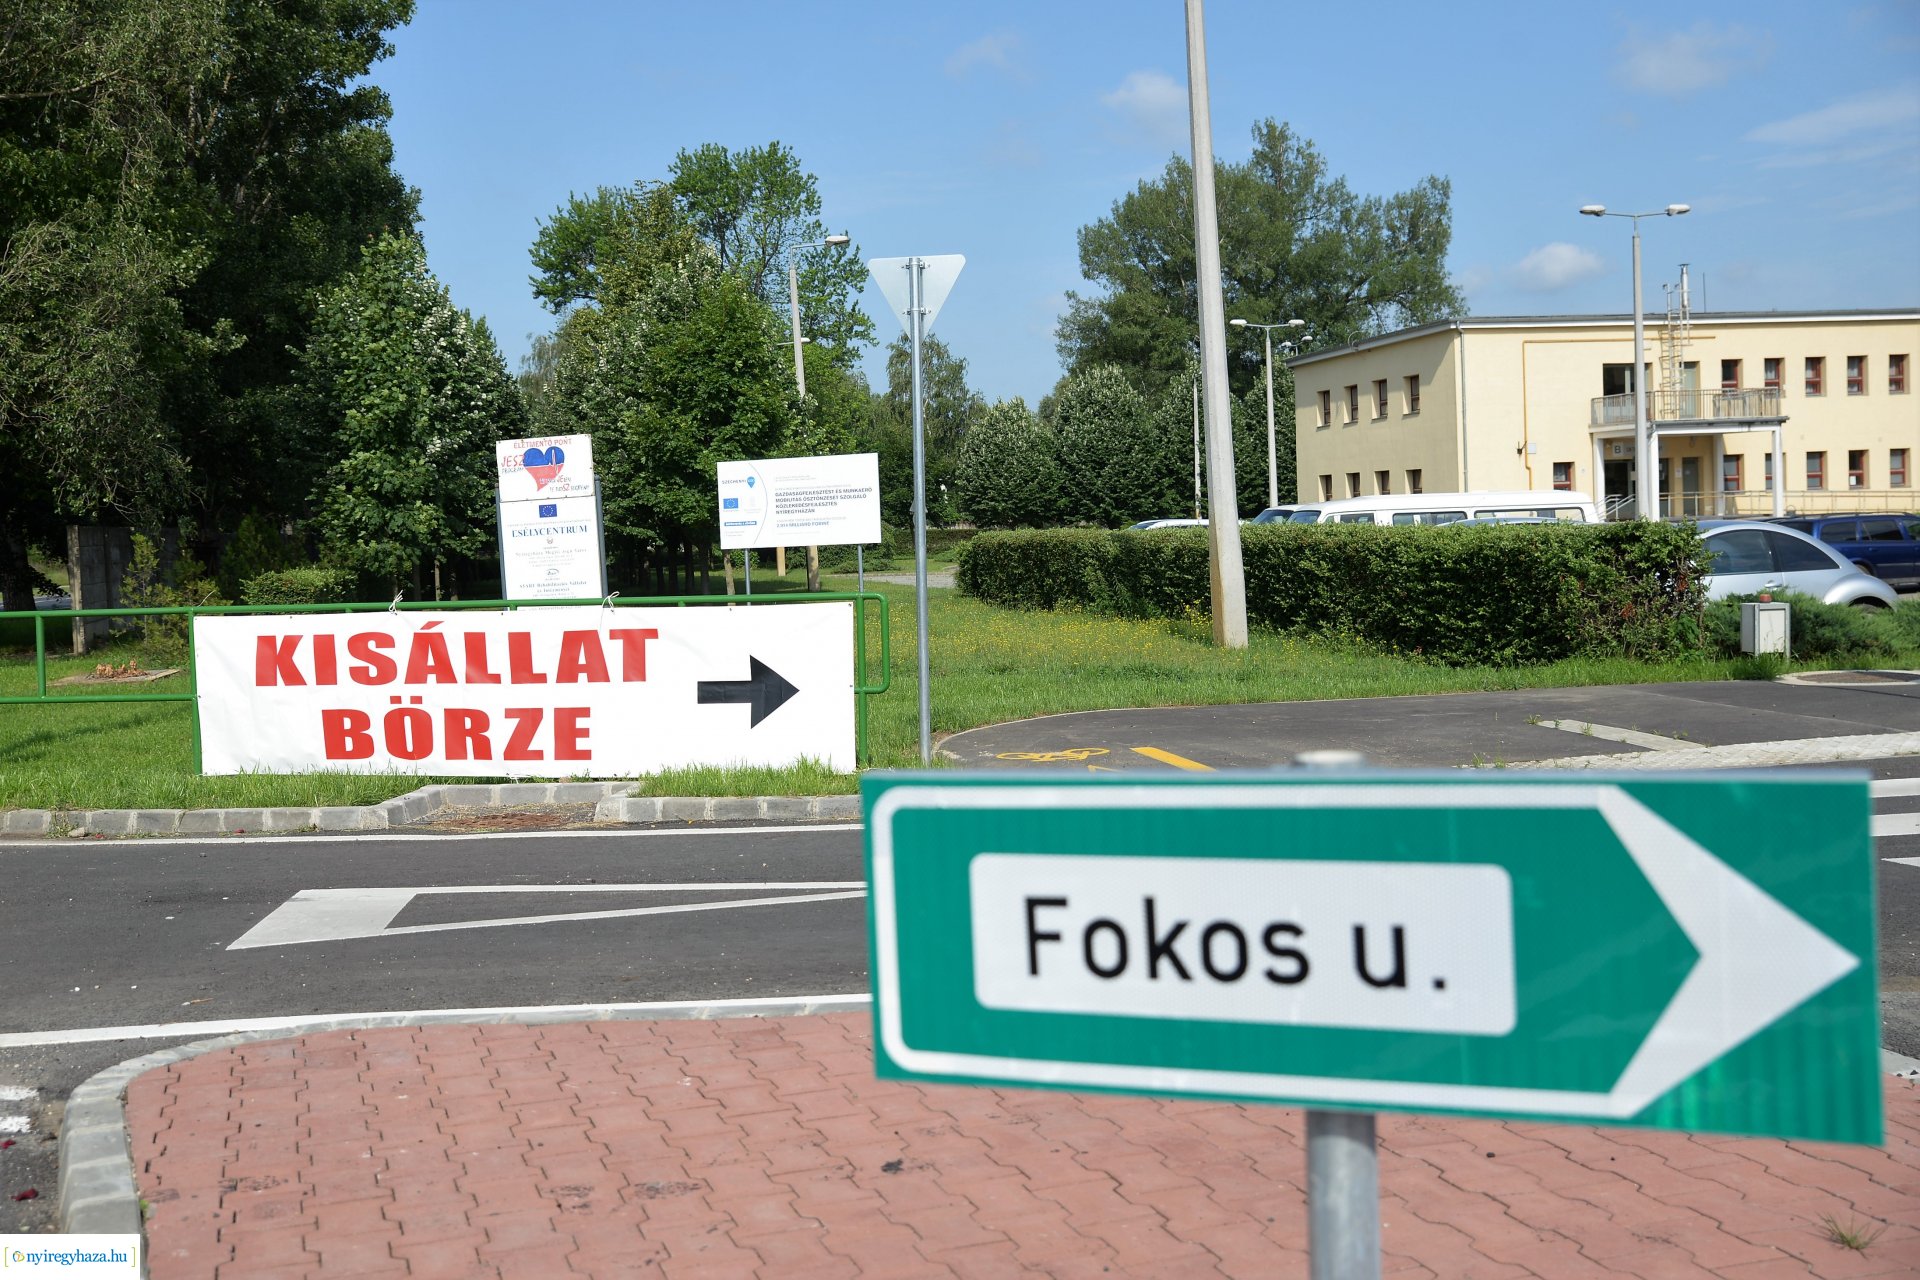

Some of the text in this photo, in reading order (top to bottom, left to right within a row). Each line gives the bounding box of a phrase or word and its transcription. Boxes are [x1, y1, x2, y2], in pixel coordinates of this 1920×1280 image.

[554, 438, 572, 446] PONT
[512, 525, 587, 538] ESÉLYCENTRUM
[254, 620, 659, 687] KISÁLLAT
[321, 695, 592, 762] BÖRZE
[1024, 896, 1447, 990] Fokos u.
